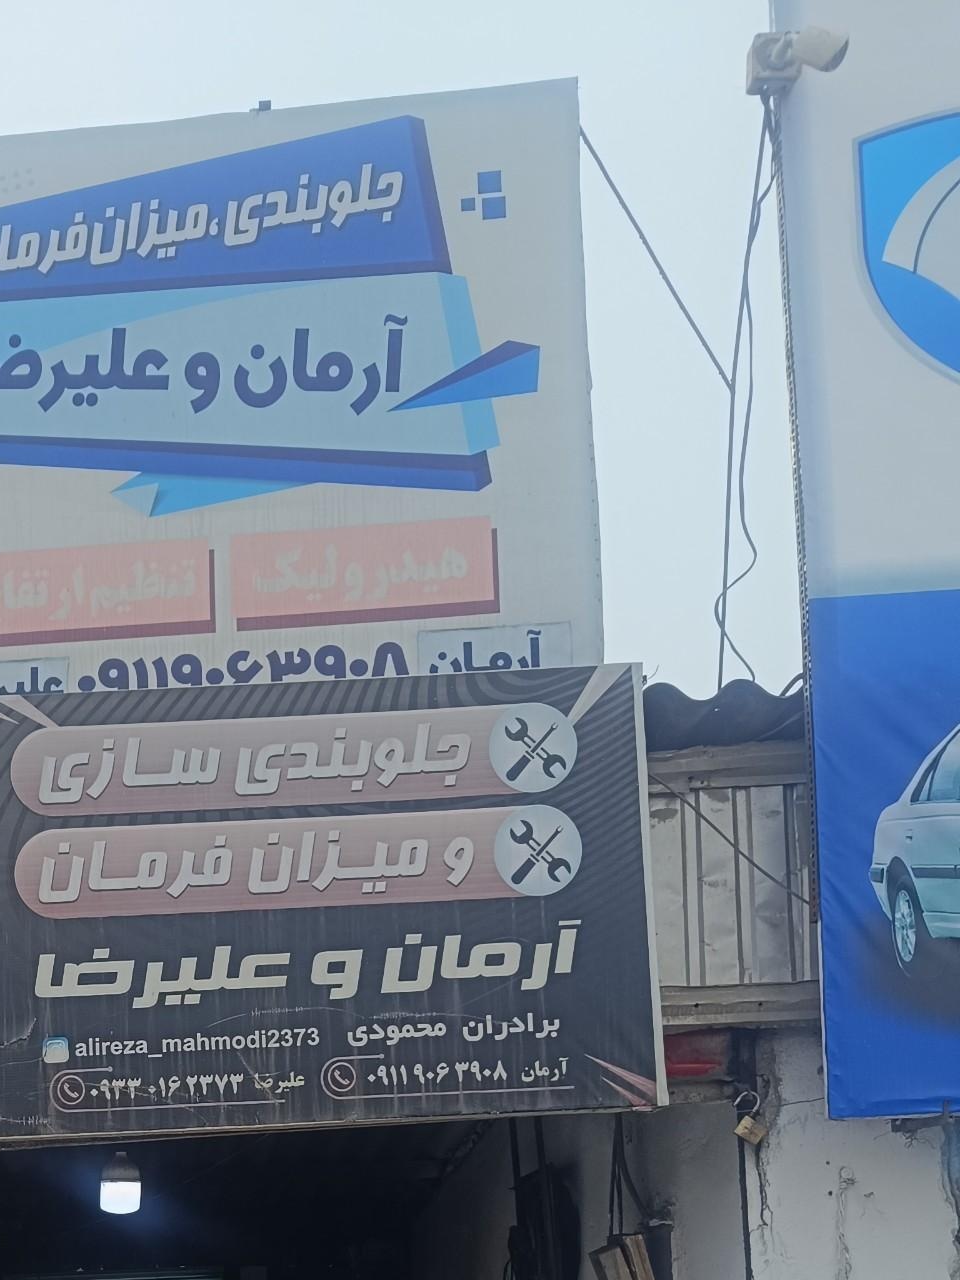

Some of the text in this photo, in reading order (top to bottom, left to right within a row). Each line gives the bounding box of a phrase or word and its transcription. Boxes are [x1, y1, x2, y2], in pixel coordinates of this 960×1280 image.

[89, 198, 208, 267] میزان
[183, 351, 222, 414] و
[233, 313, 409, 416] آرمان
[233, 722, 473, 797] جلوبندی
[38, 829, 475, 904] و میزان فرمان
[34, 918, 582, 1009] آرمان و علیرضا
[74, 1026, 321, 1059] alireza_mahmodi2373
[347, 1012, 561, 1047] برادران محمودی
[520, 1056, 570, 1082] آرمان
